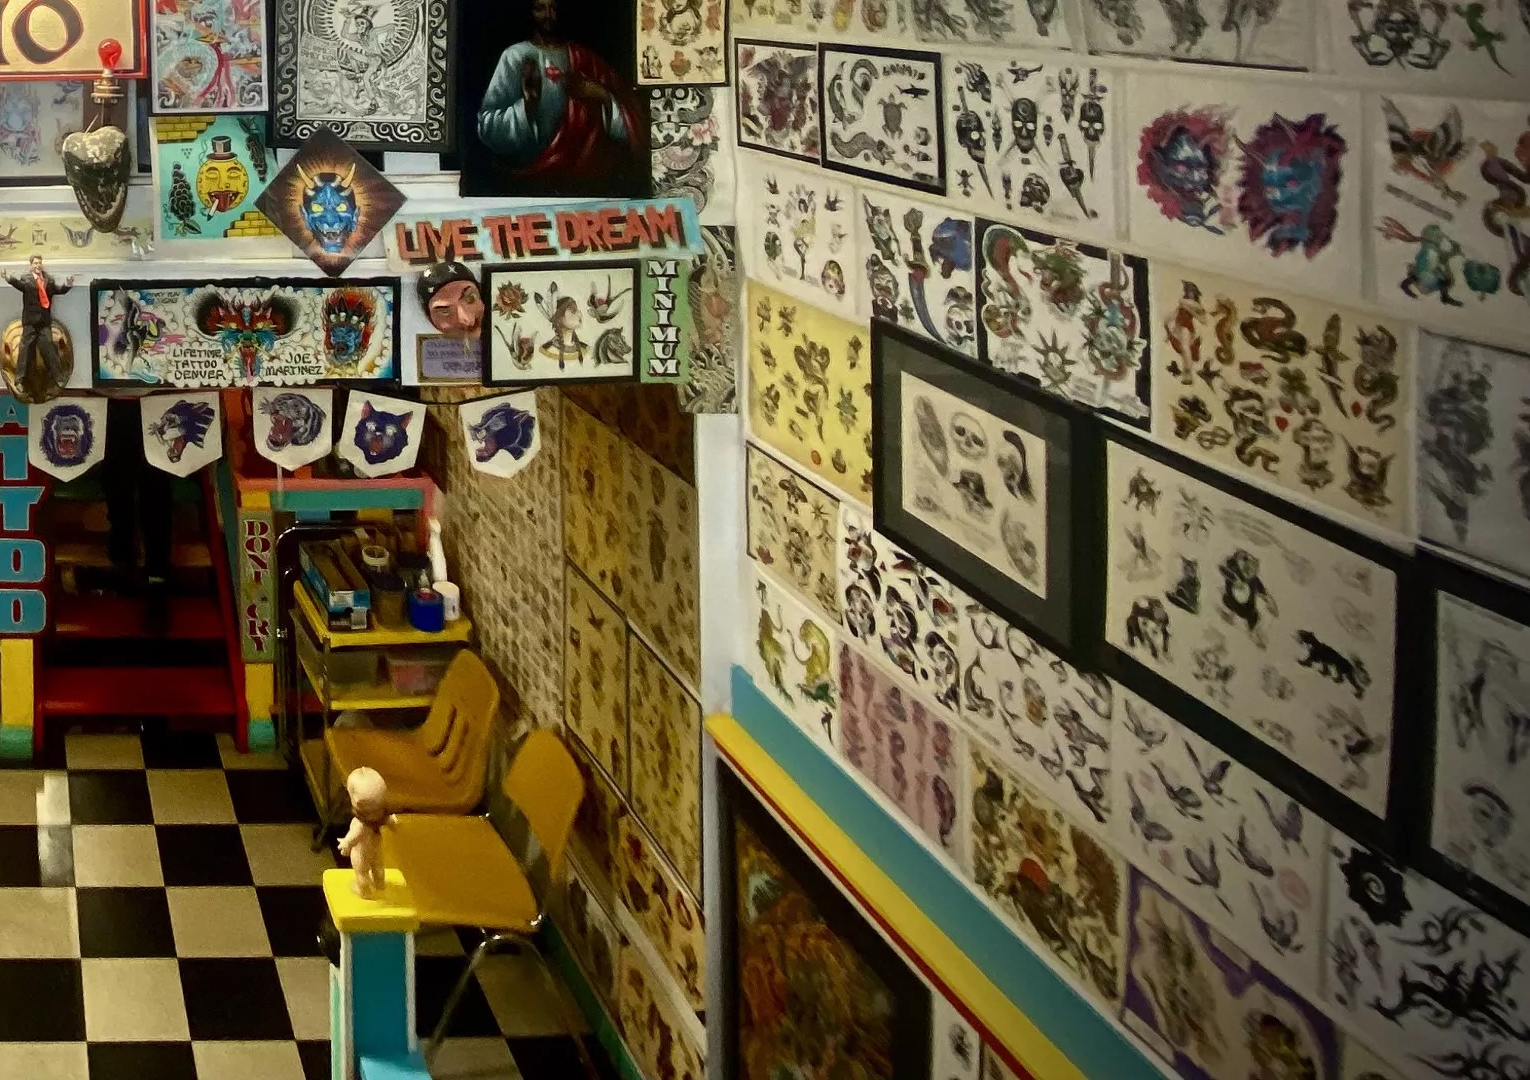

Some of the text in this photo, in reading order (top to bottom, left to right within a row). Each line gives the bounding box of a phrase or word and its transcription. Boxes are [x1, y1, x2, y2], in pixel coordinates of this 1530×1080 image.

[396, 205, 687, 264] LIVE THE DREAM
[647, 260, 679, 376] MINIMUM
[172, 347, 222, 358] LIFETIME
[173, 358, 218, 369] TATTOO
[284, 352, 312, 365] JOE
[174, 369, 227, 380] DENVER
[265, 365, 323, 376] MARTINEZ
